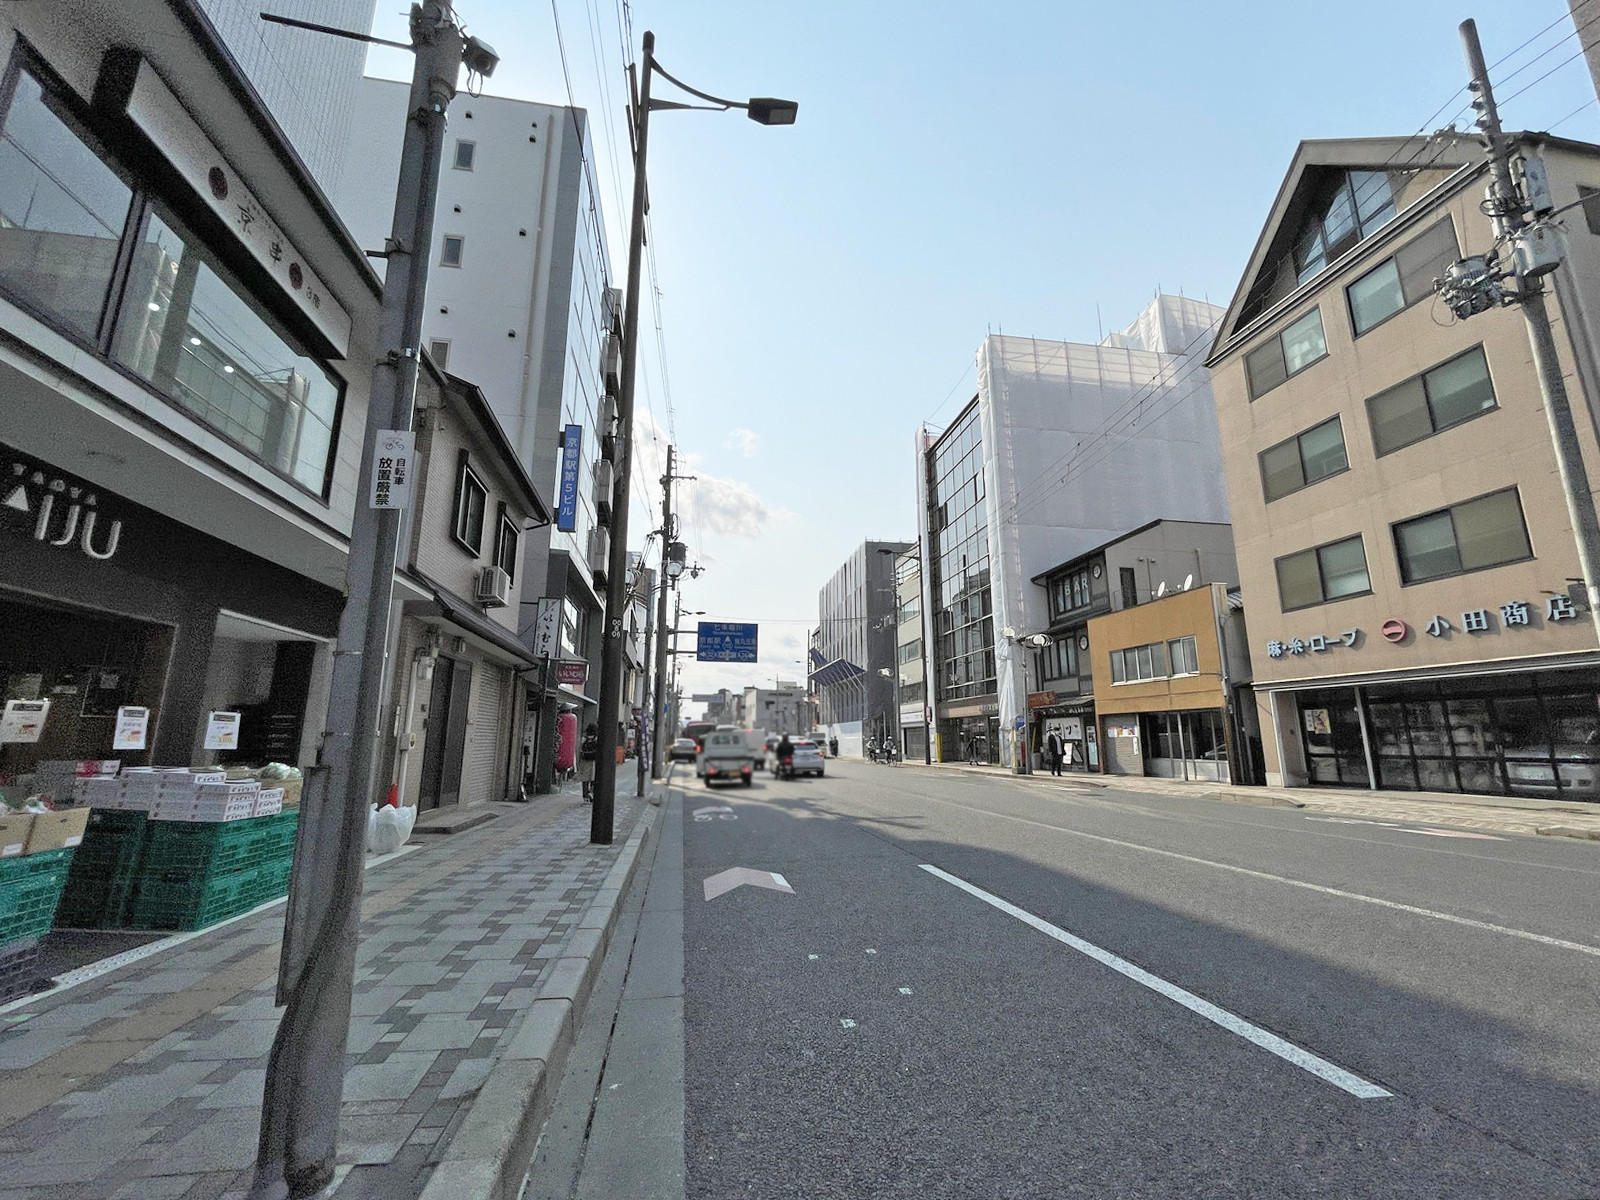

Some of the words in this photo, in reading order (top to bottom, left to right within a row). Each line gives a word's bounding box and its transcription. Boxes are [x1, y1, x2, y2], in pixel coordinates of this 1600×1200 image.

[375, 457, 393, 506] 放置厳禁
[393, 458, 406, 486] 自転車
[562, 437, 578, 516] 京都駅第5ビル
[1064, 578, 1089, 596] BAR
[1425, 594, 1577, 637] 小田商店
